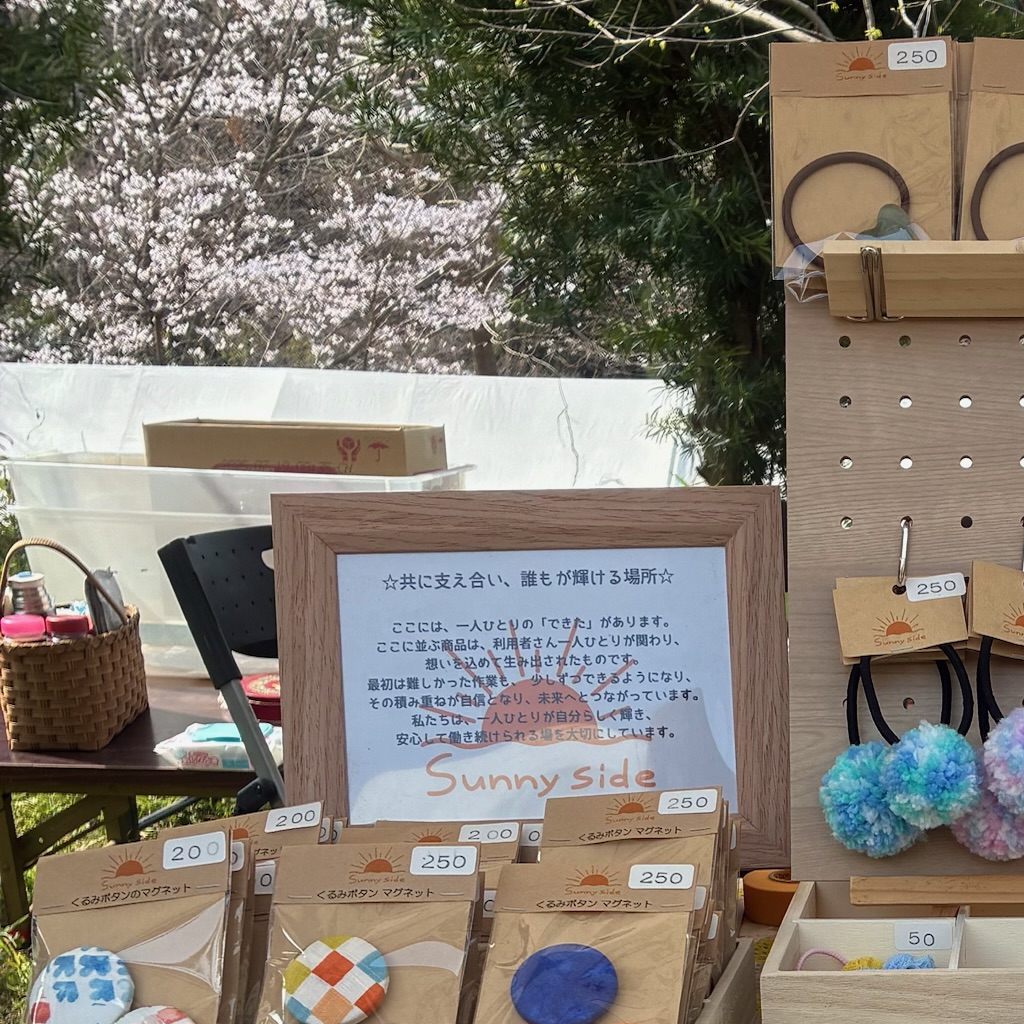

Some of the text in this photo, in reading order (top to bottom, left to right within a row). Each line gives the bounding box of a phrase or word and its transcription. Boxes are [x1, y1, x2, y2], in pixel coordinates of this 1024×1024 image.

[896, 50, 938, 65] 250
[917, 580, 957, 595] 250
[874, 633, 927, 647] Sunny side
[426, 753, 657, 798] Sunny side
[667, 797, 709, 810] 250
[276, 810, 316, 827] 200
[468, 829, 513, 841] 200
[171, 841, 219, 862] 200
[421, 853, 467, 869] 250
[101, 876, 157, 892] Sunny side
[349, 875, 406, 886] Sunny side
[639, 871, 683, 885] 250
[383, 887, 435, 899] マグネット
[565, 887, 621, 897] Sunny side
[908, 931, 936, 947] 50
